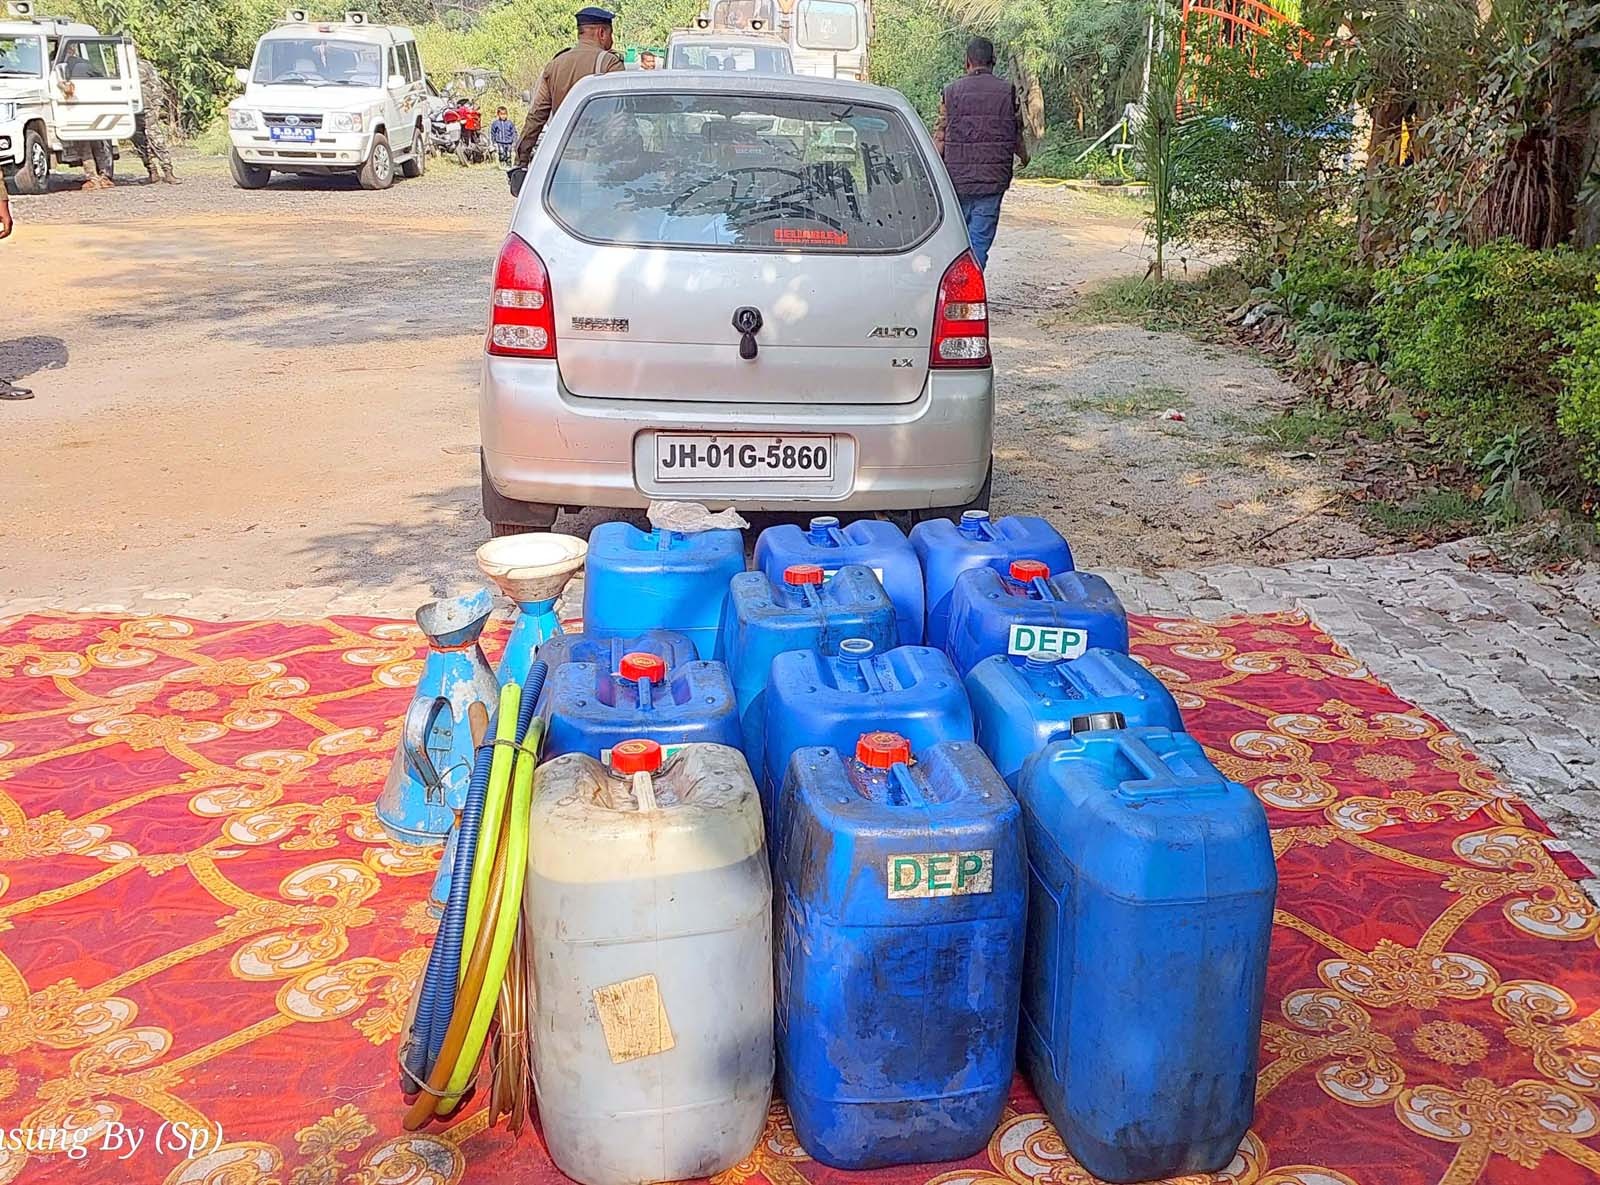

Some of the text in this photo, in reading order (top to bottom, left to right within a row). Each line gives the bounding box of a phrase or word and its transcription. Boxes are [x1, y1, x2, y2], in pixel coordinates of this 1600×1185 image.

[866, 326, 918, 338] ALTO
[892, 358, 913, 368] LX
[662, 444, 828, 470] JH-01G-5860
[1014, 627, 1081, 655] DEP
[893, 854, 983, 892] DEP
